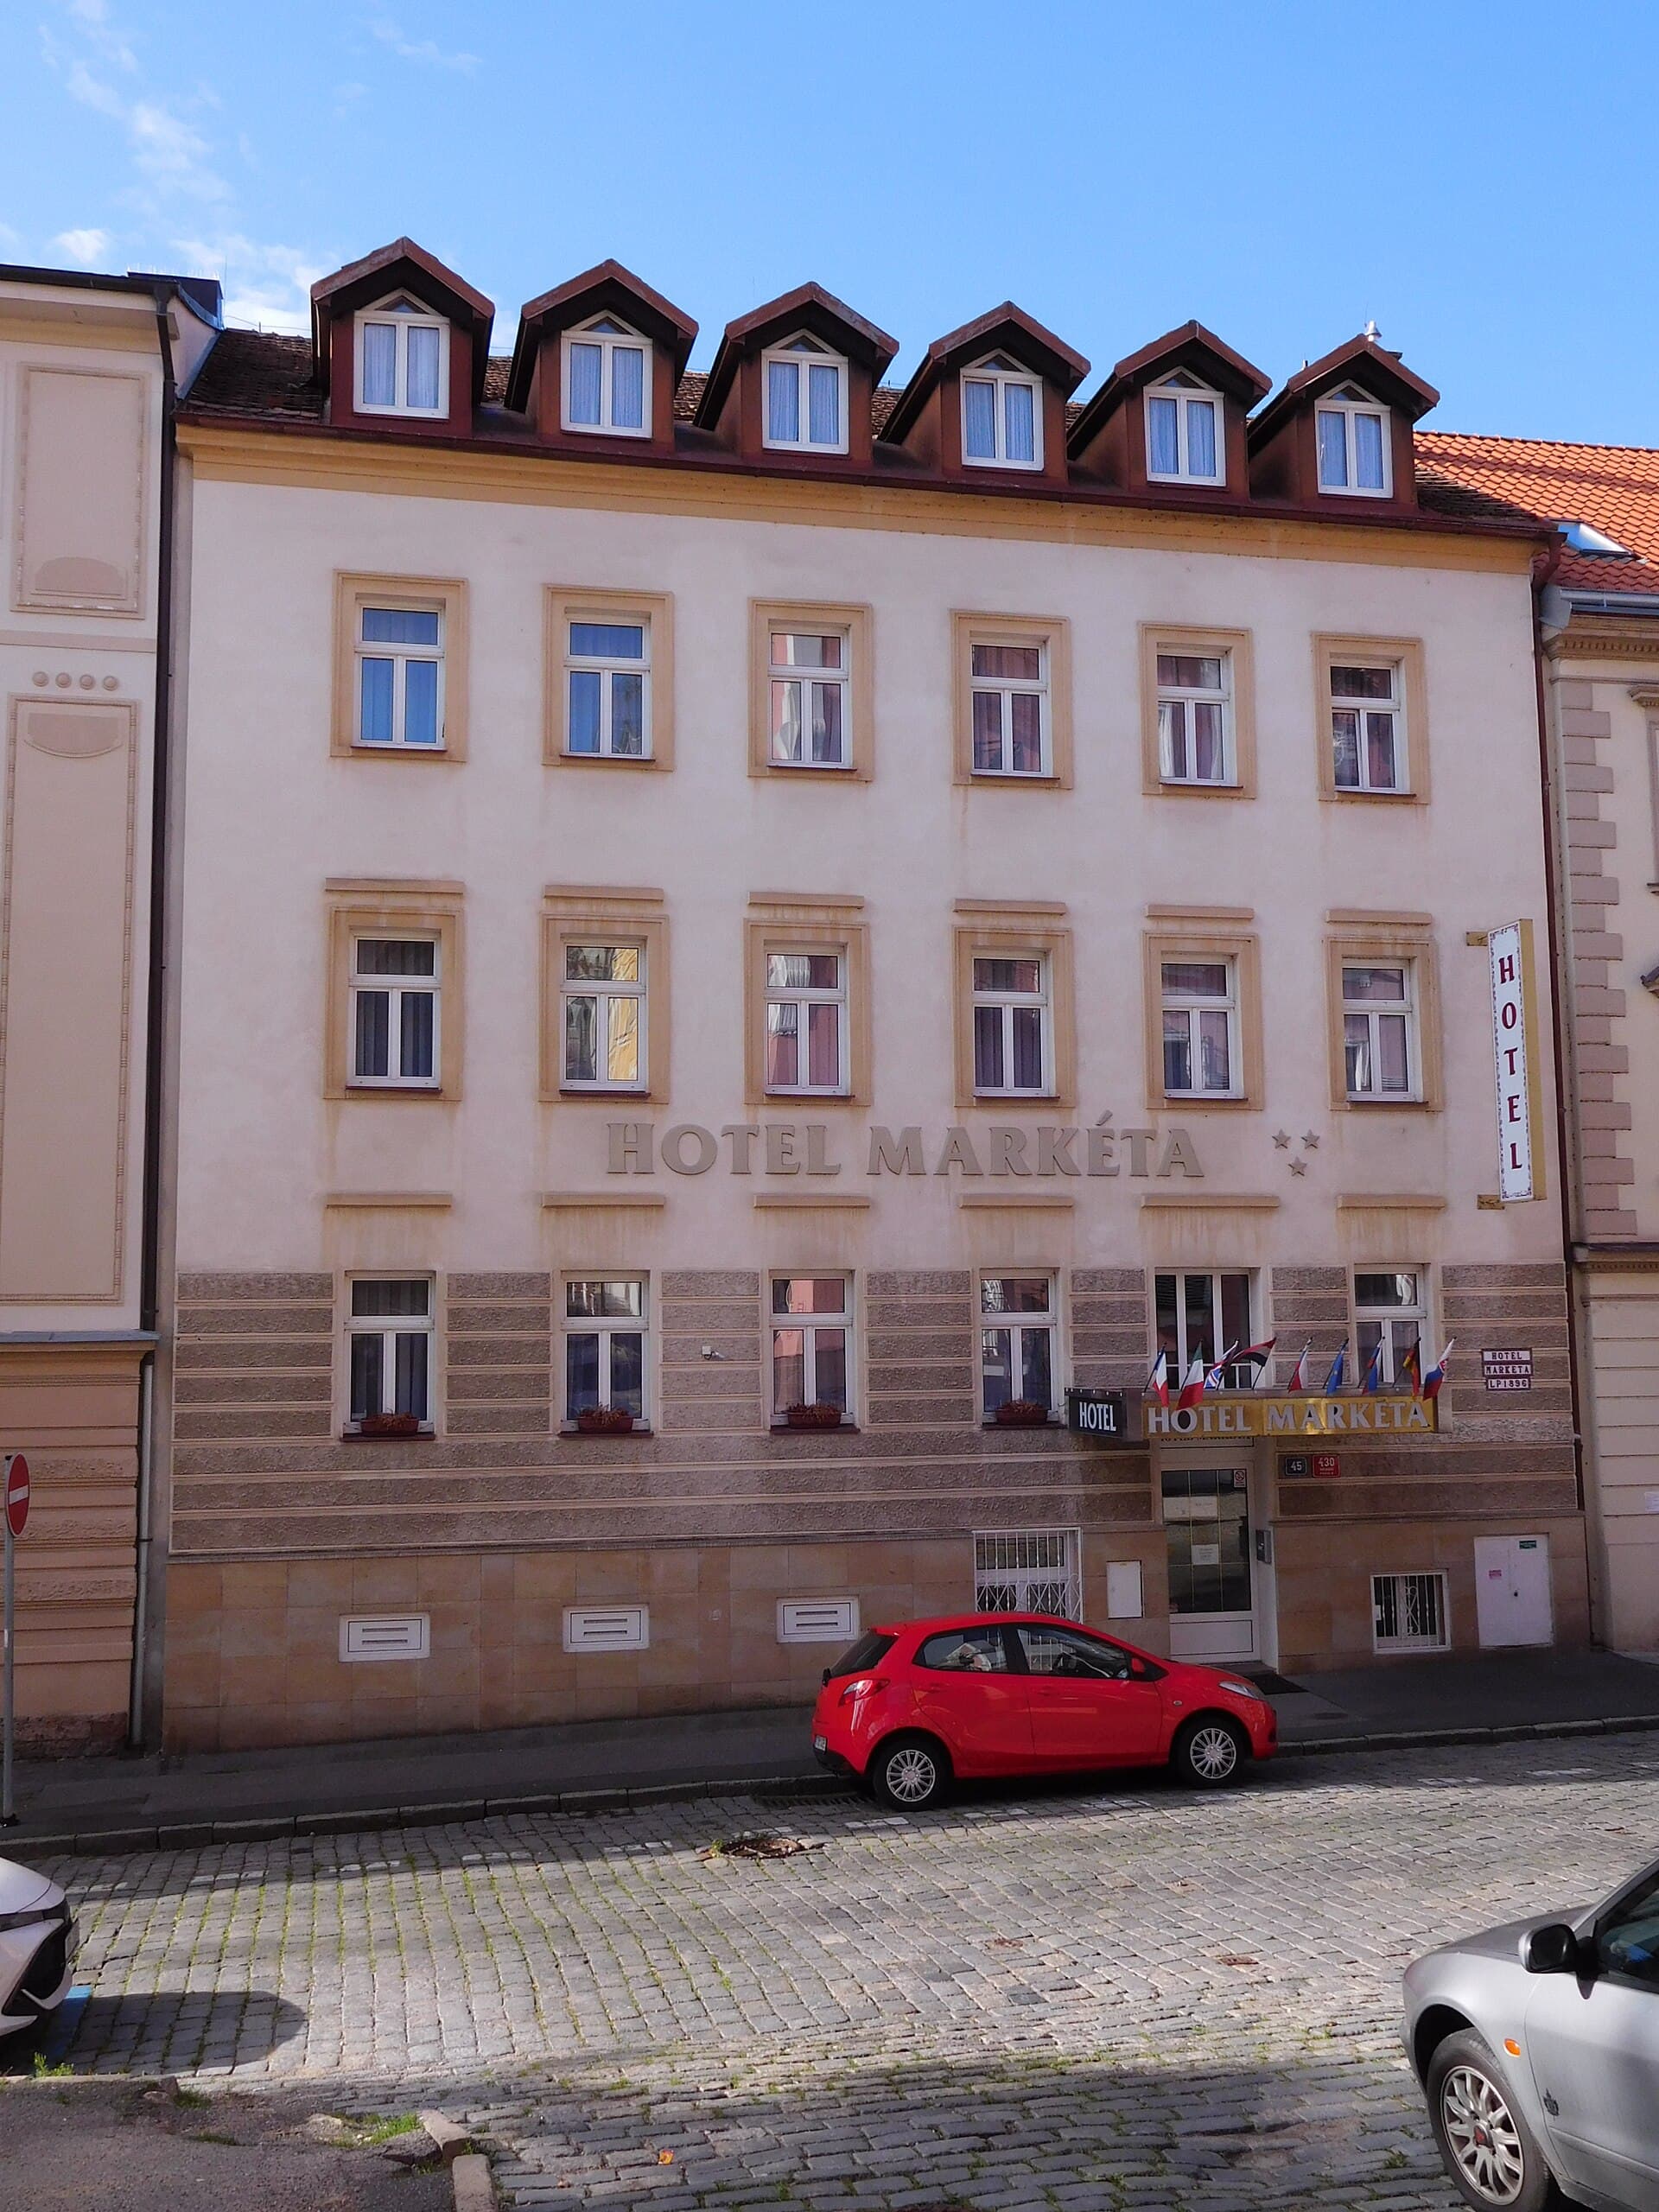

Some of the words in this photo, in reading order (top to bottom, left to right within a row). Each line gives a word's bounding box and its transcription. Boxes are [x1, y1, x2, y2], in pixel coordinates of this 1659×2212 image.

[1498, 954, 1522, 1170] HOTEL
[607, 1123, 842, 1175] HOTEL
[866, 1109, 1205, 1178] MARKÉTA
[1491, 1351, 1522, 1360] HOTEL
[1079, 1402, 1116, 1432] HOTEL
[1147, 1406, 1252, 1433] HOTEL
[1290, 1460, 1302, 1471] 45
[1318, 1457, 1335, 1467] 430
